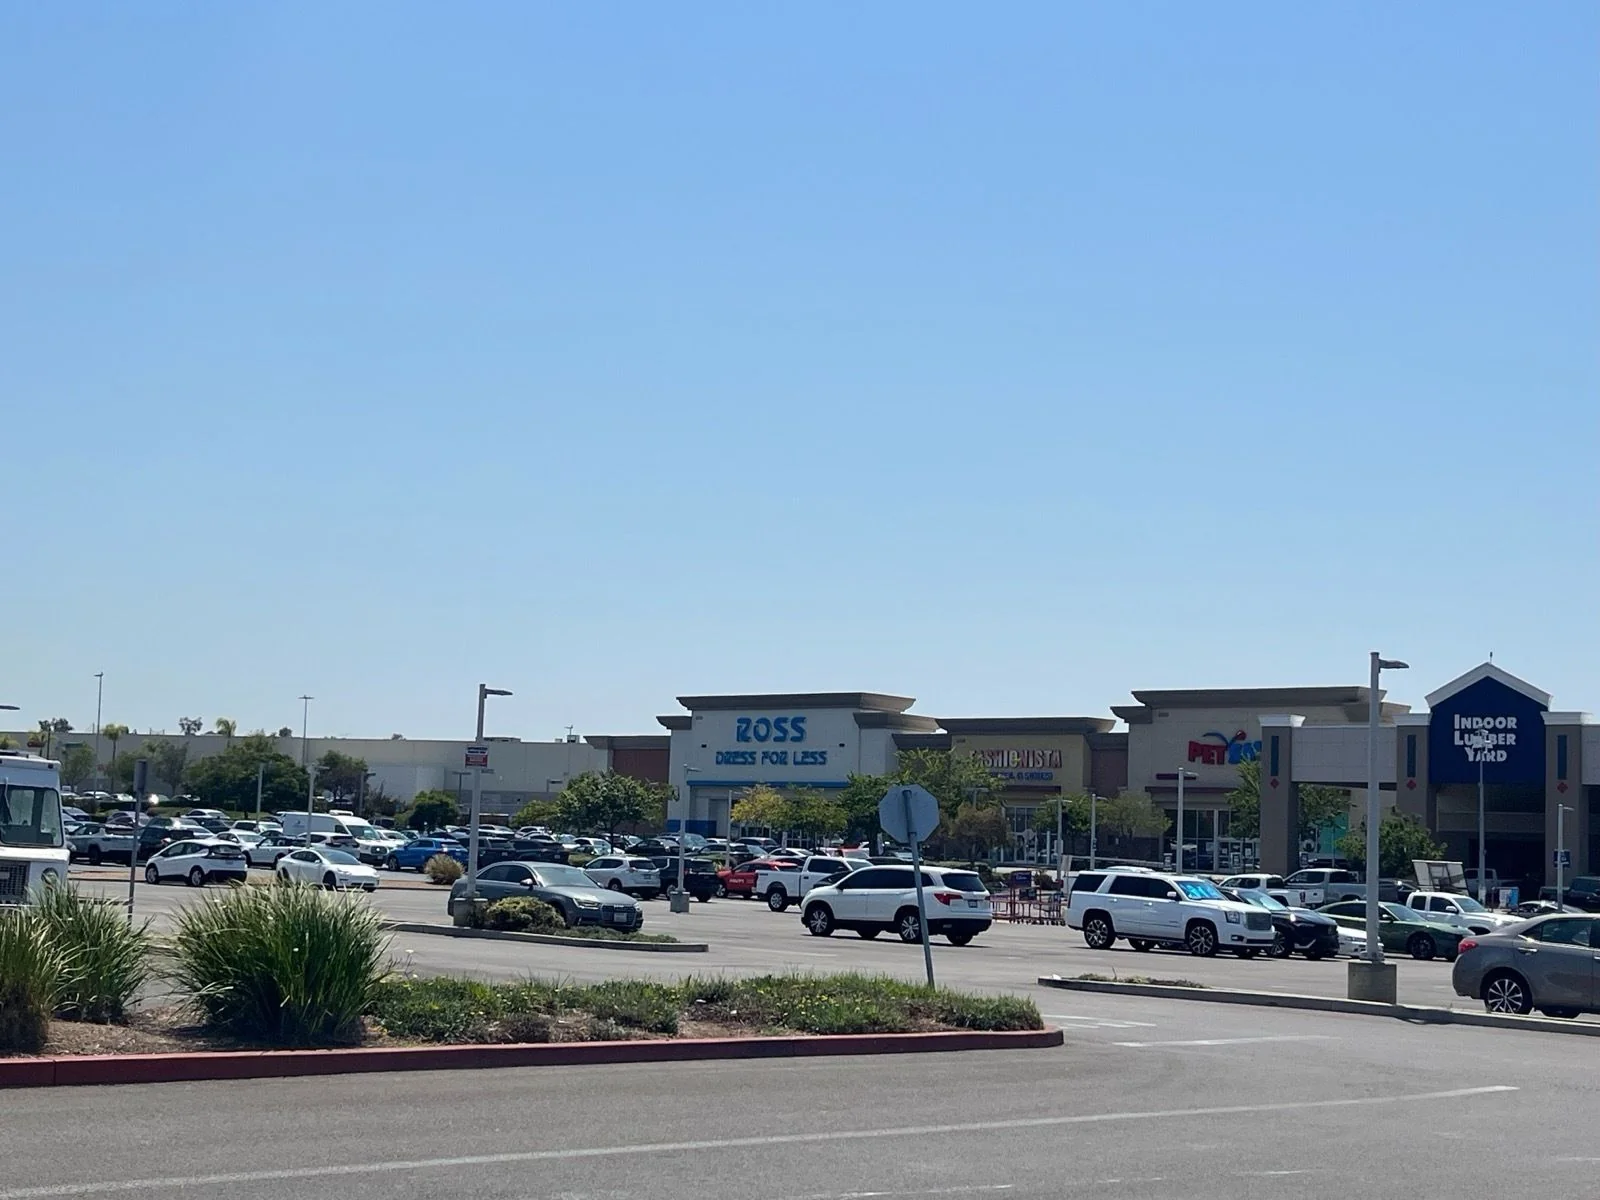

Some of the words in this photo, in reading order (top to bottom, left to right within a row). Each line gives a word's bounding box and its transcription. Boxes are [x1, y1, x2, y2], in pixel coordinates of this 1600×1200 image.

[1454, 714, 1517, 729] INDOOR
[736, 717, 807, 742] ROSS
[1454, 730, 1516, 746] LUBER
[715, 751, 757, 765] DRESS
[761, 751, 788, 765] FOR
[793, 751, 828, 765] LESS
[1464, 747, 1507, 762] YARD
